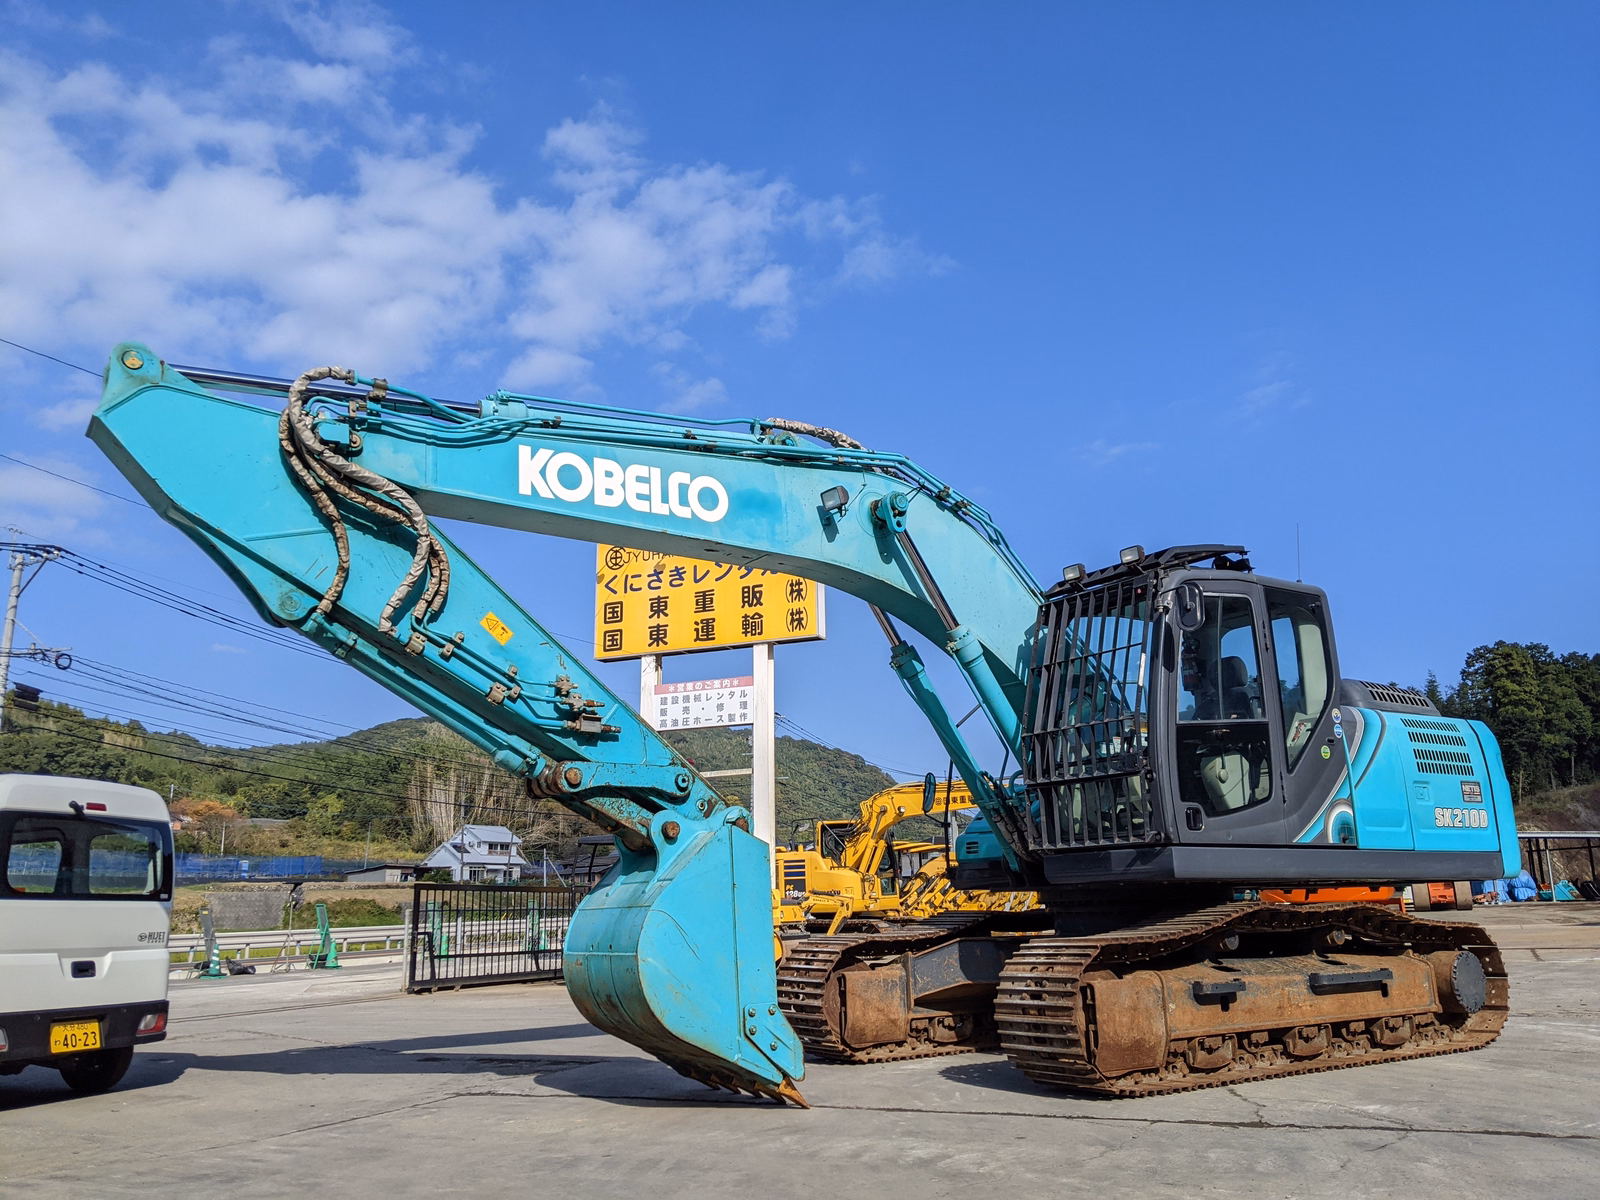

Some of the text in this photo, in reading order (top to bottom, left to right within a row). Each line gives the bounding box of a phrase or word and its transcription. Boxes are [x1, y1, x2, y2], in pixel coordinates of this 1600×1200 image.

[518, 444, 729, 523] KOBELCO
[659, 690, 748, 706] 建設機械レンタル
[659, 712, 748, 728] 高油圧ホース製作
[1434, 805, 1489, 828] SK210D
[148, 931, 166, 940] HIJET
[63, 1031, 97, 1049] 40-23
